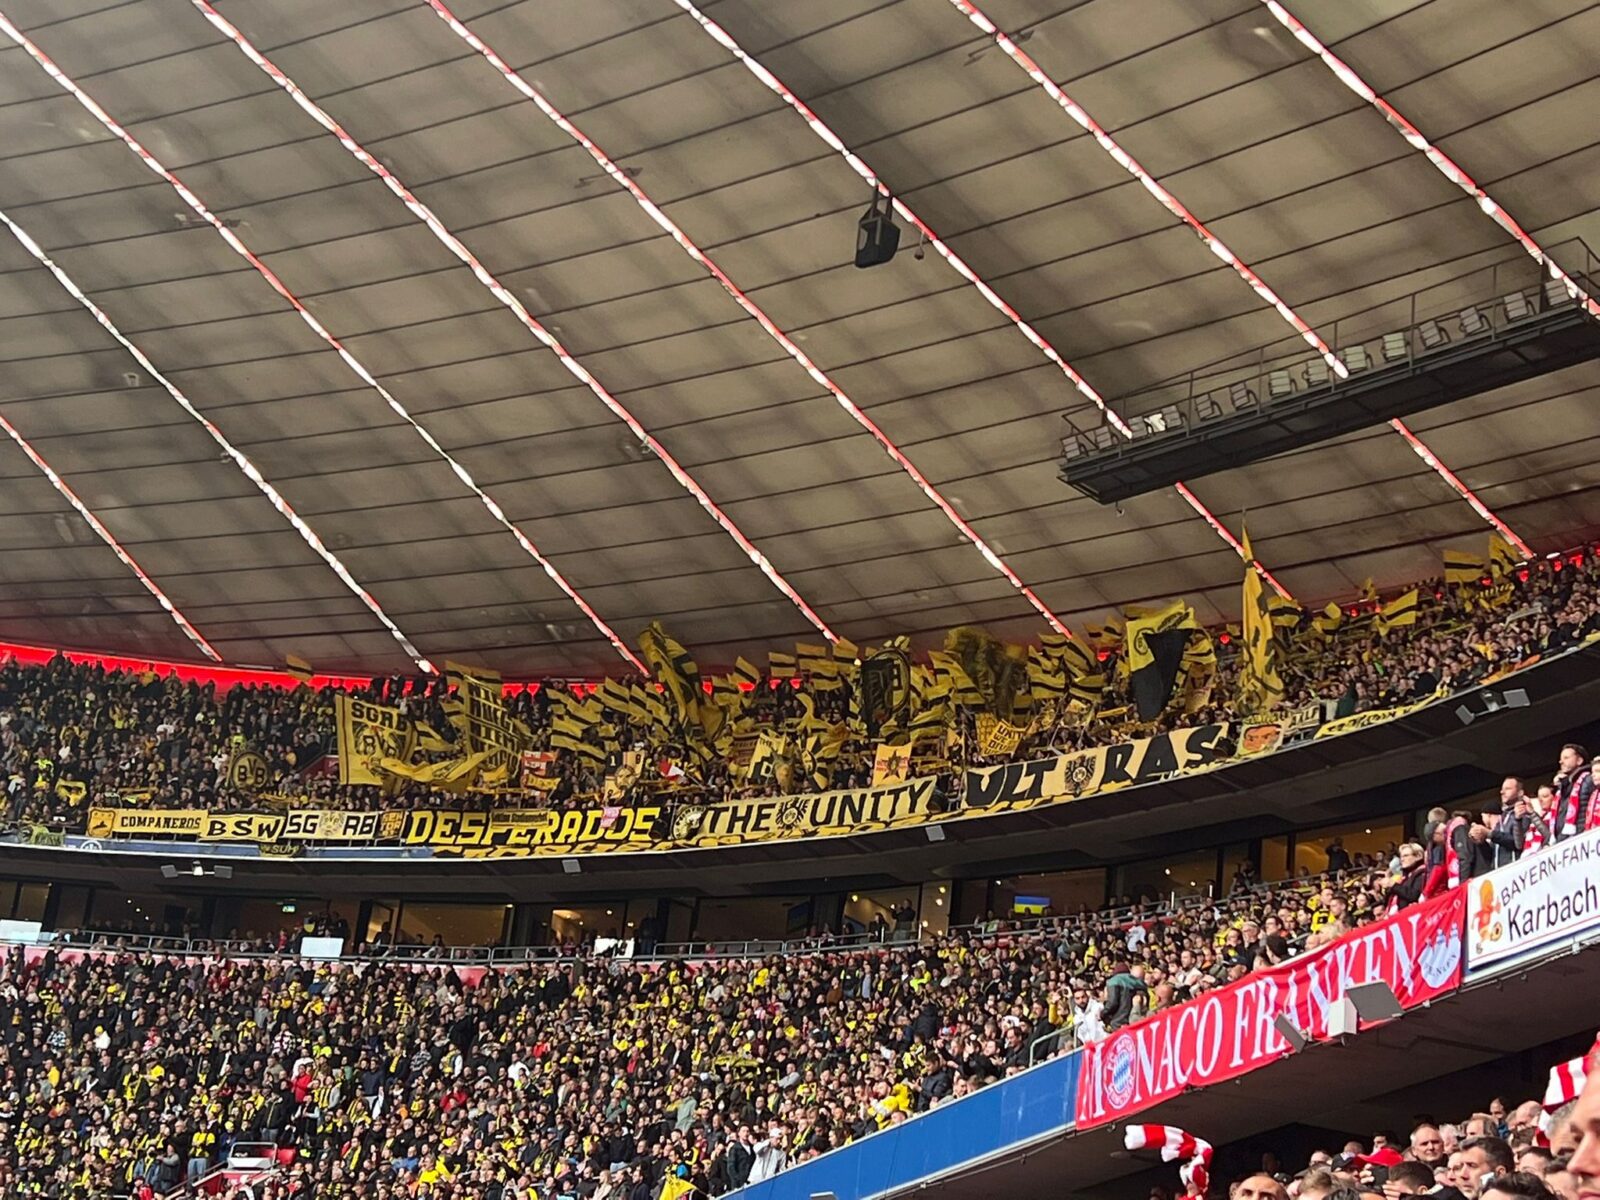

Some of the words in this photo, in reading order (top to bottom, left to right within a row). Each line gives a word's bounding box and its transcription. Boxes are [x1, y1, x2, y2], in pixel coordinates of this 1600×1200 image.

[238, 758, 265, 784] BVB
[705, 804, 777, 834] THE
[810, 780, 934, 826] UNITY
[207, 817, 281, 838] BSW
[286, 814, 320, 834] SG
[342, 815, 377, 836] RB
[1507, 877, 1598, 942] Karbach
[1229, 912, 1422, 1068] FRANKEN
